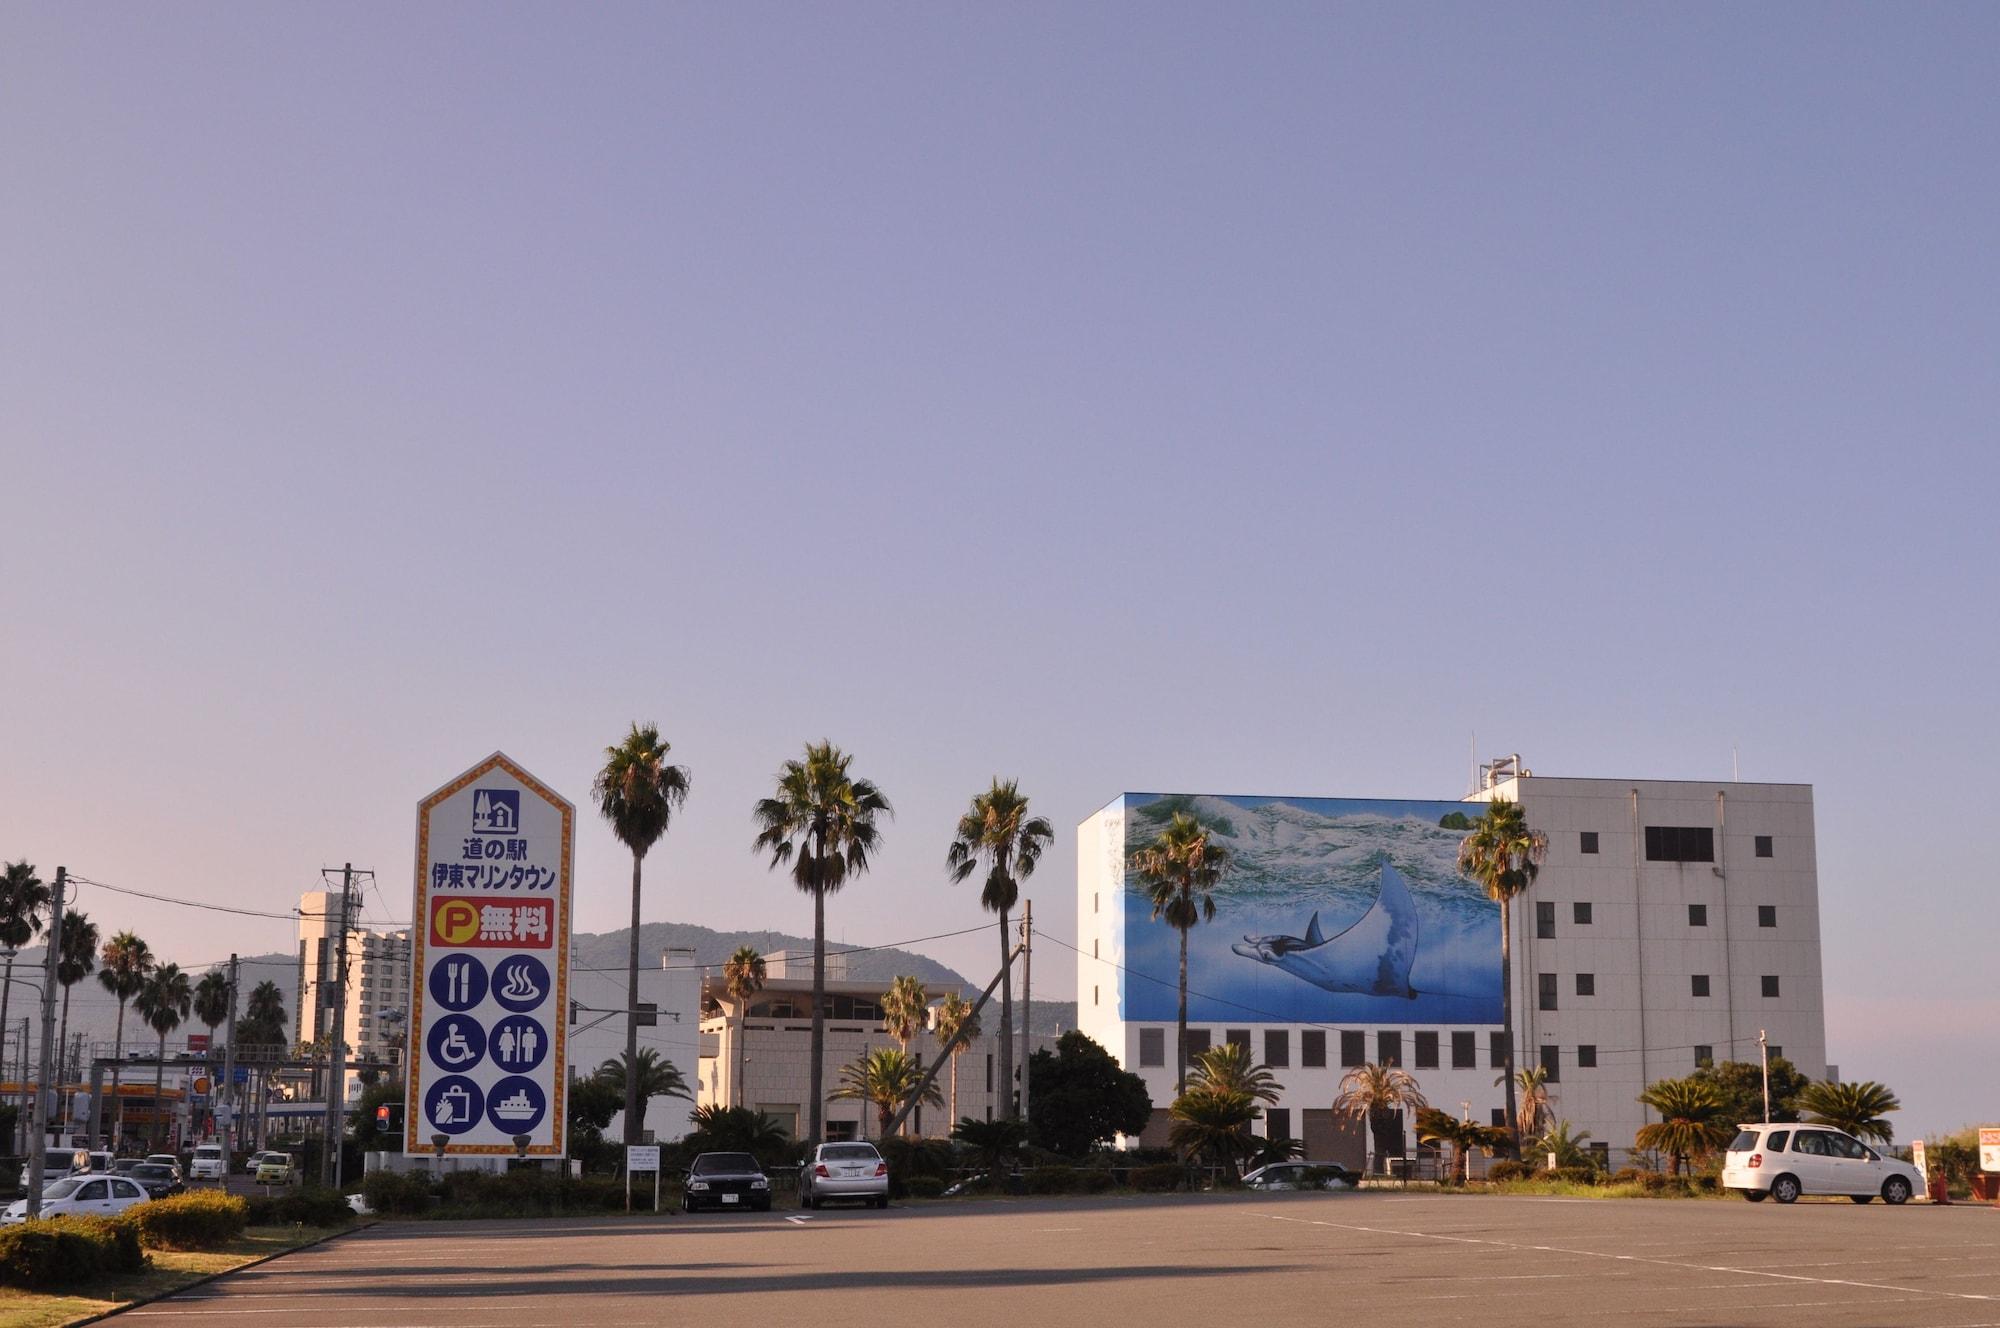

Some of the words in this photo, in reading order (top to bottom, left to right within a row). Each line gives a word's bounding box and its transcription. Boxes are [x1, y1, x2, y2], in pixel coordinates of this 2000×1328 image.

[462, 838, 528, 861] 道の駅
[432, 862, 556, 890] 伊東マリンタウン
[445, 907, 473, 938] P
[480, 905, 548, 942] 無料
